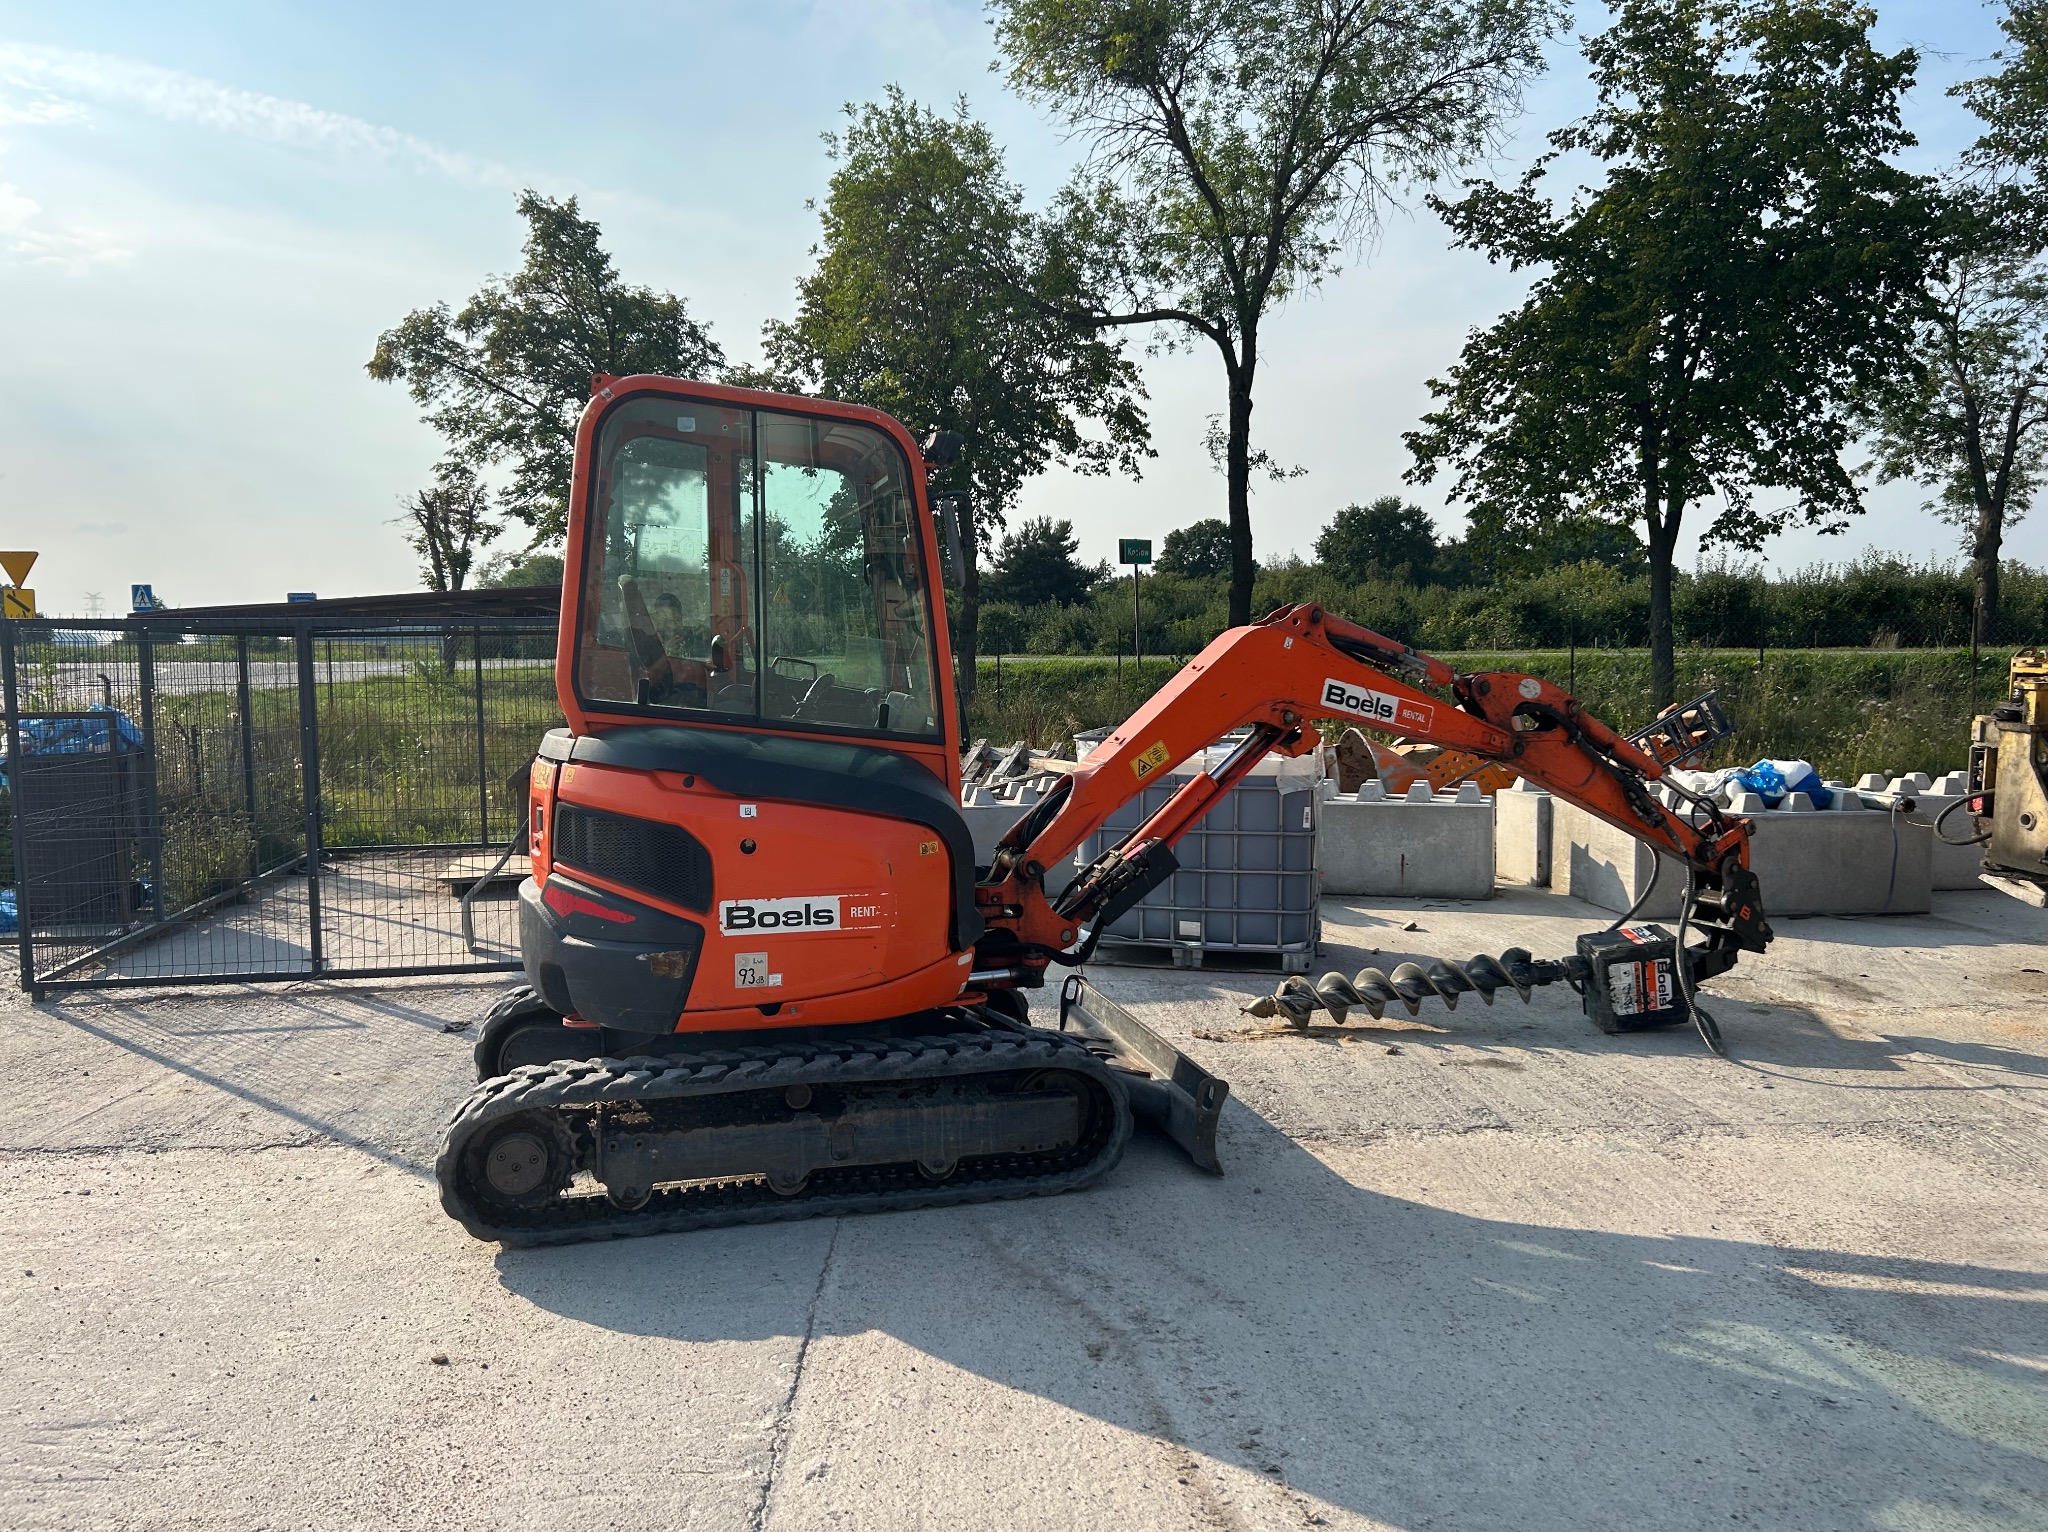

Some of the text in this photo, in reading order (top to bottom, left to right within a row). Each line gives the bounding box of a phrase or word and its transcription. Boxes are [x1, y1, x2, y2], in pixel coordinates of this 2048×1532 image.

[1325, 684, 1426, 723] Boels RENTAL
[725, 903, 884, 930] Boels RENT
[738, 968, 755, 985] 93
[1657, 961, 1670, 1006] Boels
